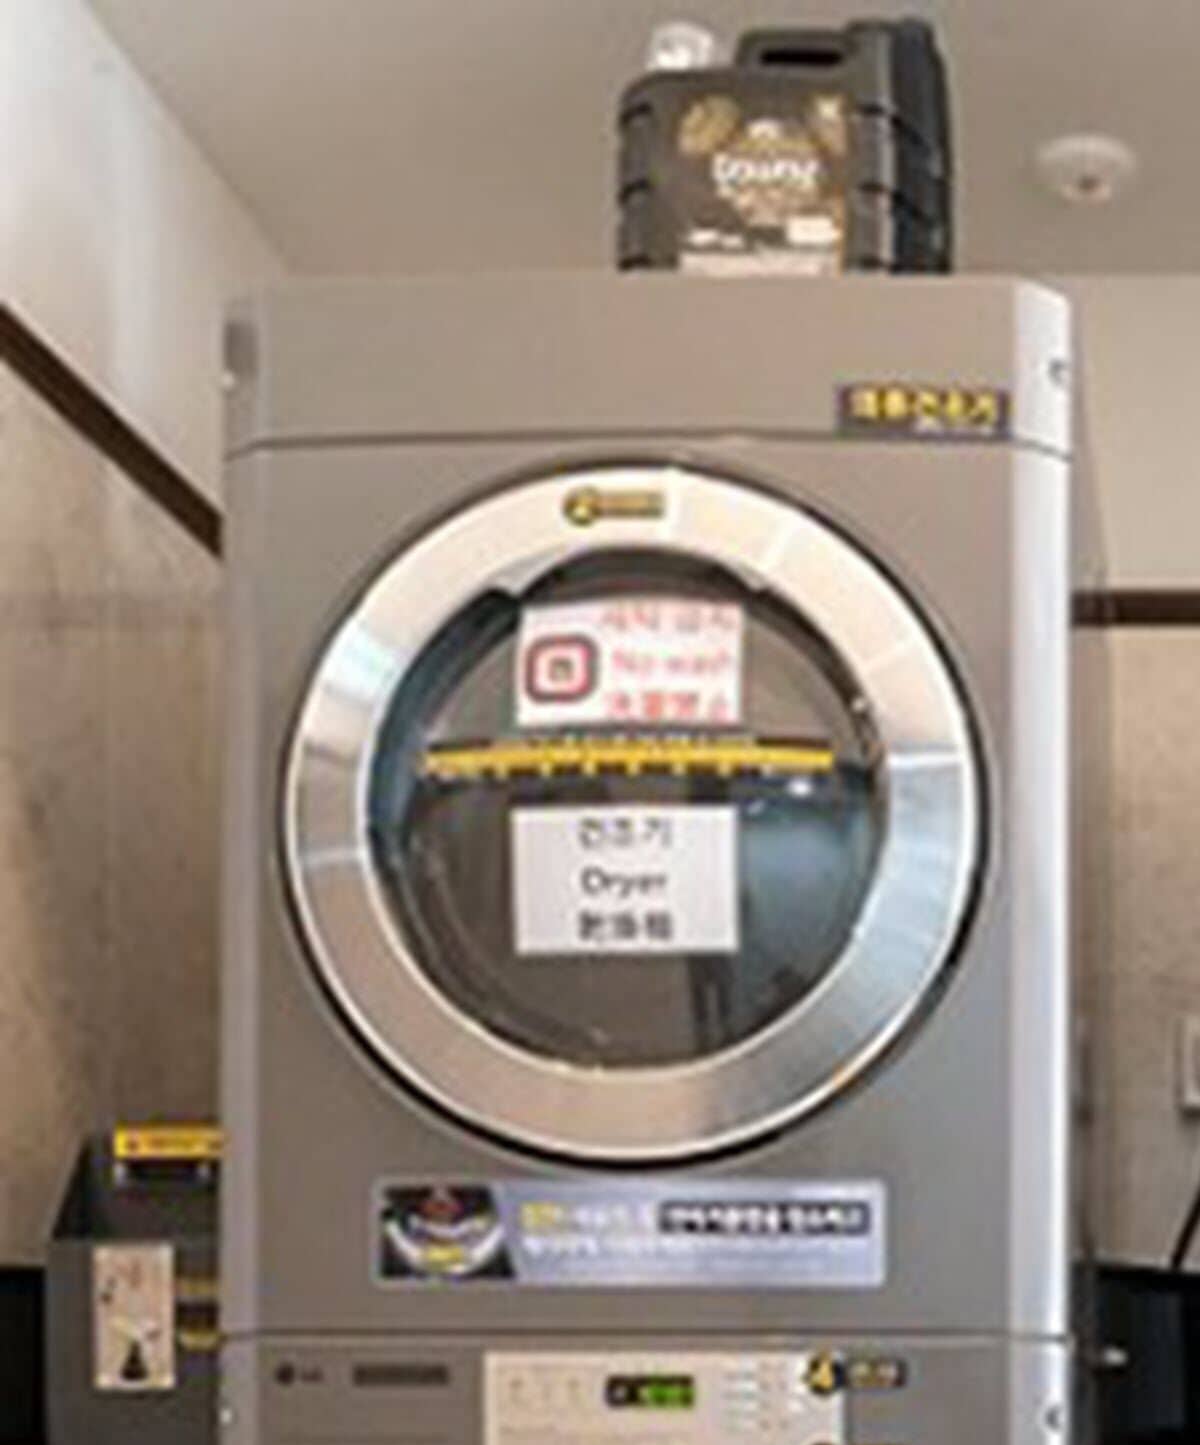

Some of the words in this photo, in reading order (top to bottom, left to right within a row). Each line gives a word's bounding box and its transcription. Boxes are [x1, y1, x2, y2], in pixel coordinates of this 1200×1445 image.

[612, 650, 652, 676] No
[578, 818, 674, 848] 건조기
[580, 867, 668, 899] Dryer
